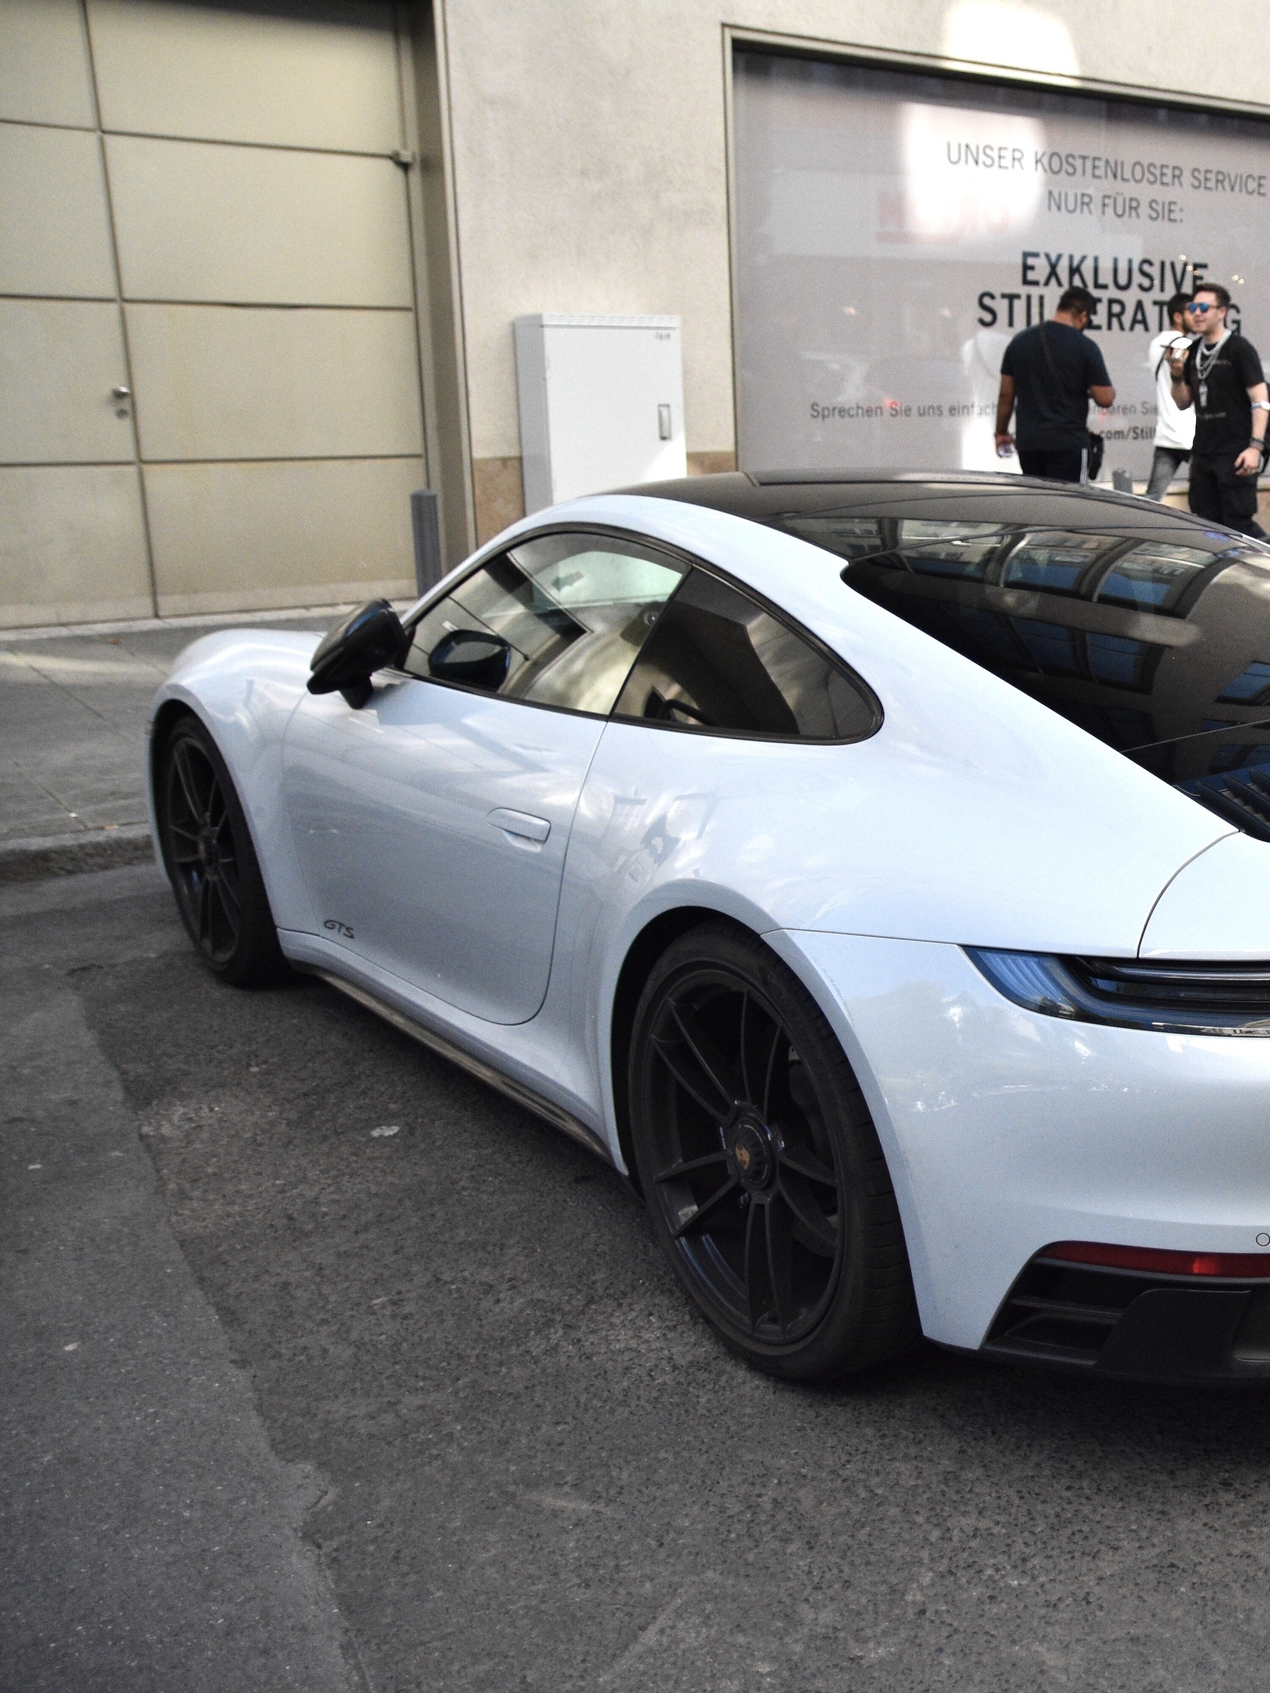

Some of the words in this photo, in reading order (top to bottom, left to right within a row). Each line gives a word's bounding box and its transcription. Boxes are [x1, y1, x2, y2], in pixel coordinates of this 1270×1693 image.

[946, 141, 1025, 171] UNSER
[1034, 151, 1183, 188] KOSTENLOSER
[1190, 167, 1267, 197] SERVICE
[1047, 190, 1093, 216] NUR
[1101, 192, 1141, 220] FÜR
[1148, 199, 1184, 223] SIE:
[1021, 250, 1209, 295] EXKLUSIVE
[809, 401, 884, 421] Sprechen
[888, 401, 911, 418] Sie
[917, 404, 943, 418] uns
[323, 919, 355, 939] GTS
